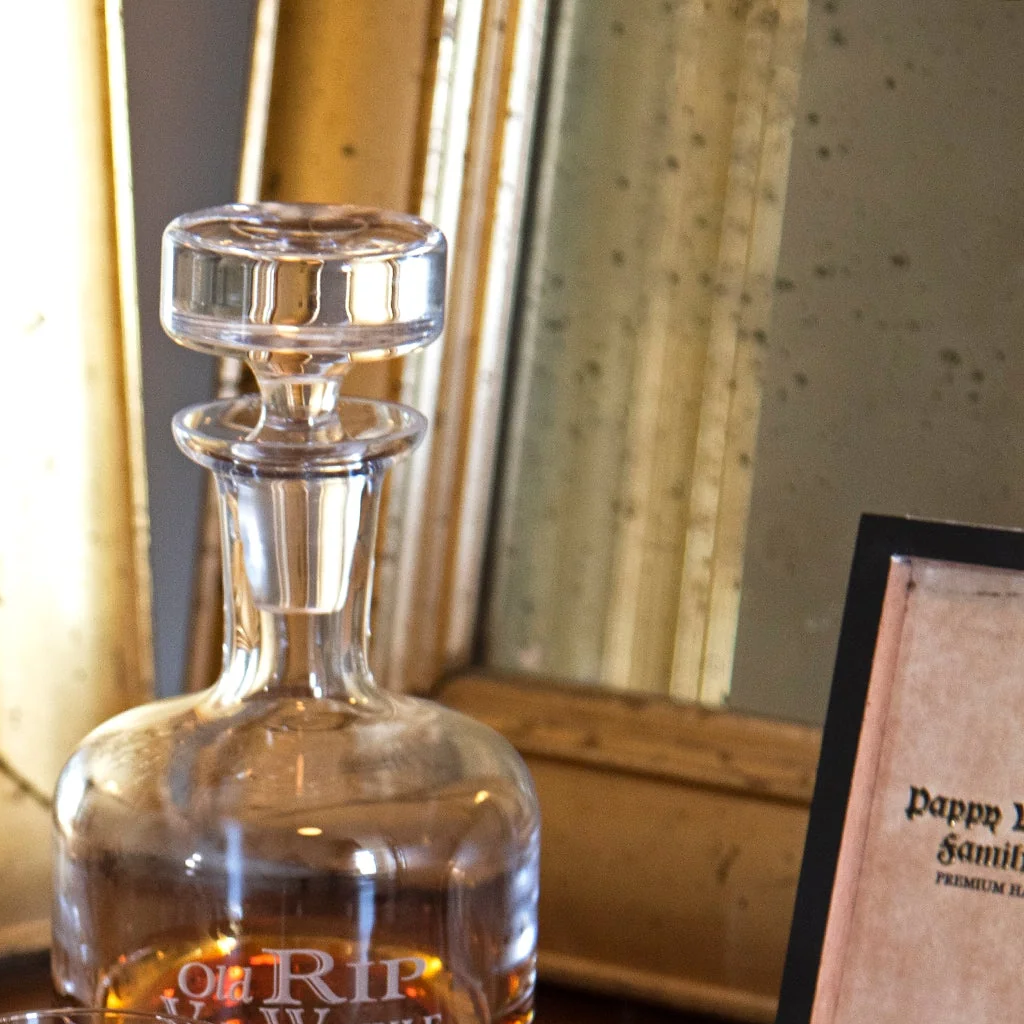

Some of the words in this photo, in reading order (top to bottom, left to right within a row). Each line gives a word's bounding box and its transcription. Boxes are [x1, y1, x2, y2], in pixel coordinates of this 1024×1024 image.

[905, 784, 1002, 835] Pappy
[936, 832, 1024, 873] Famil
[935, 870, 1005, 895] PREMIUM
[178, 961, 254, 1004] Old
[262, 947, 427, 1005] RIP
